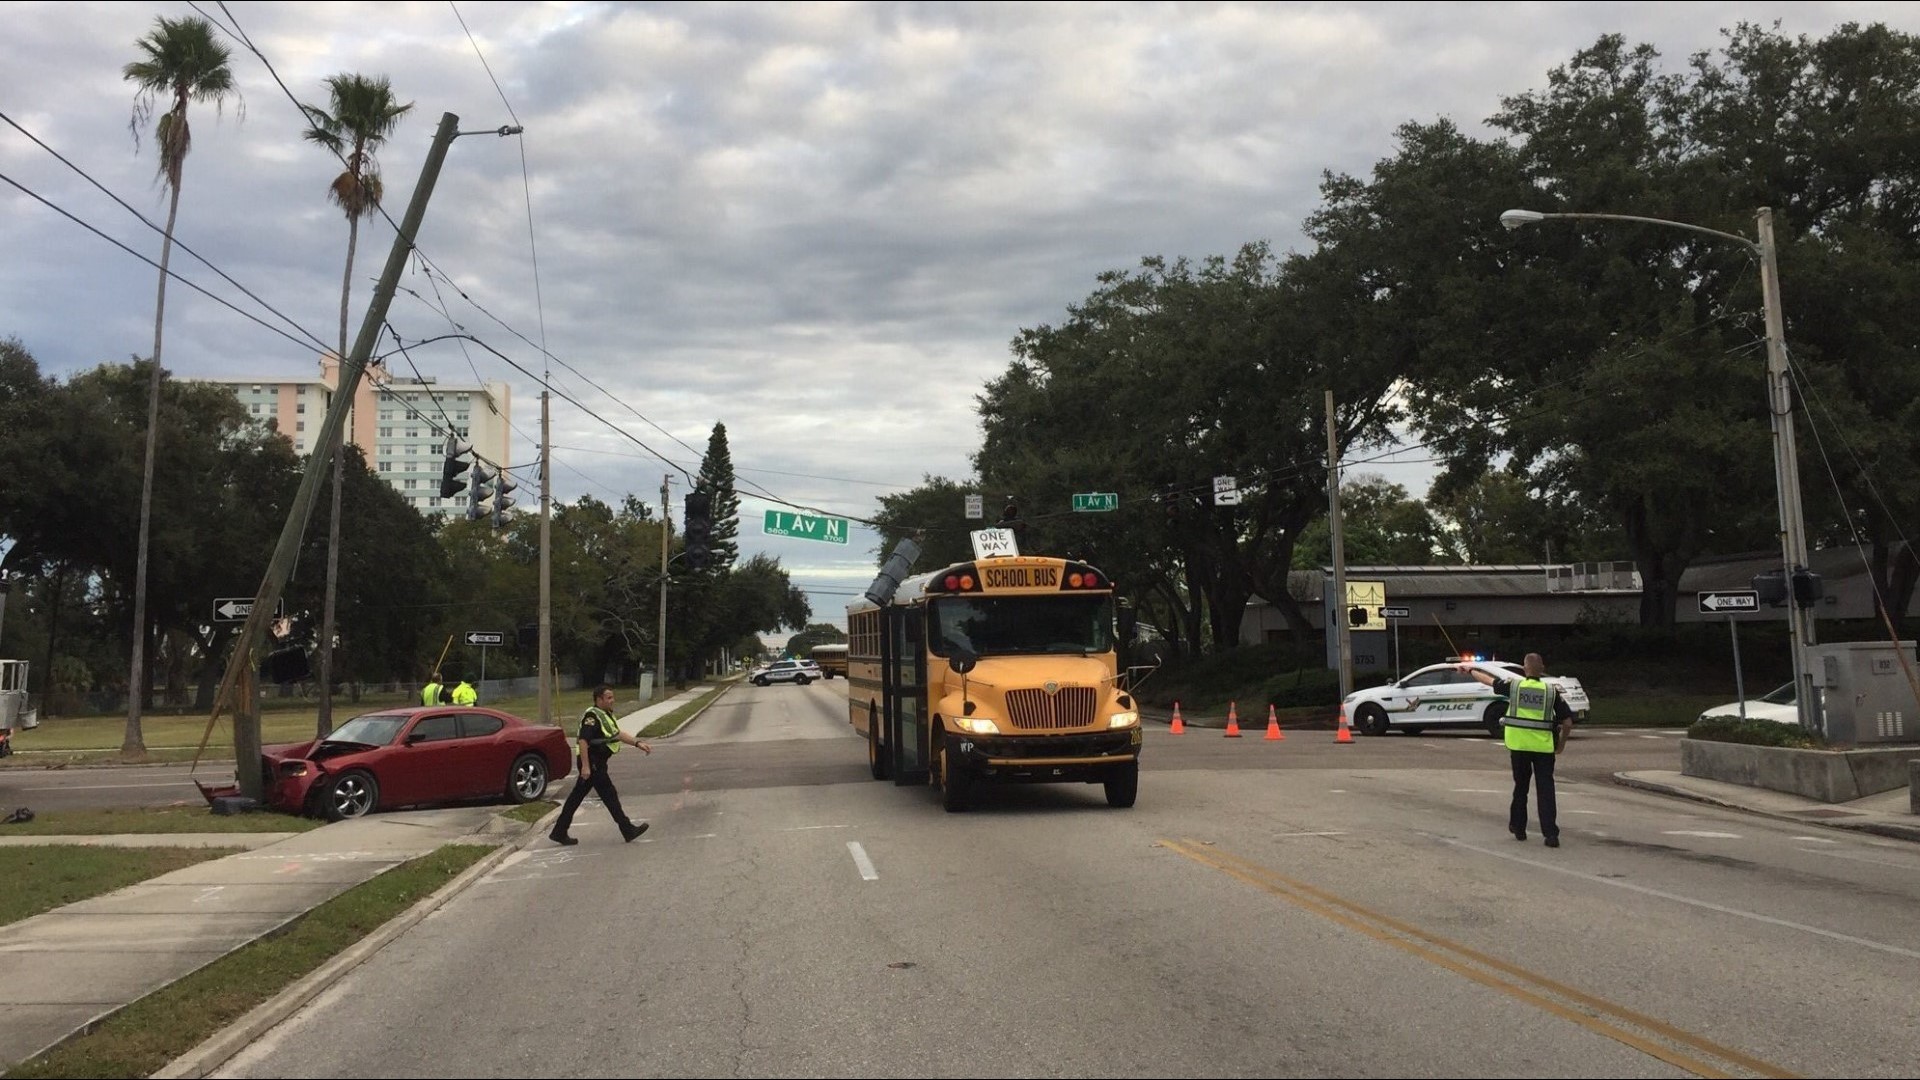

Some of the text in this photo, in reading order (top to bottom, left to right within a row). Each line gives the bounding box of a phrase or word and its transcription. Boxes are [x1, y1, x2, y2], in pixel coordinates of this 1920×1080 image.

[1087, 495, 1100, 506] Av
[1105, 495, 1112, 506] N
[776, 513, 839, 536] 1 Av N
[980, 532, 1007, 542] ONE
[982, 541, 1009, 550] WAY
[987, 567, 1057, 588] SCHOOL BUS
[1717, 596, 1752, 606] ONE WAY
[1520, 693, 1544, 705] POLICE
[1427, 703, 1474, 711] POLICE
[960, 742, 974, 752] WP
